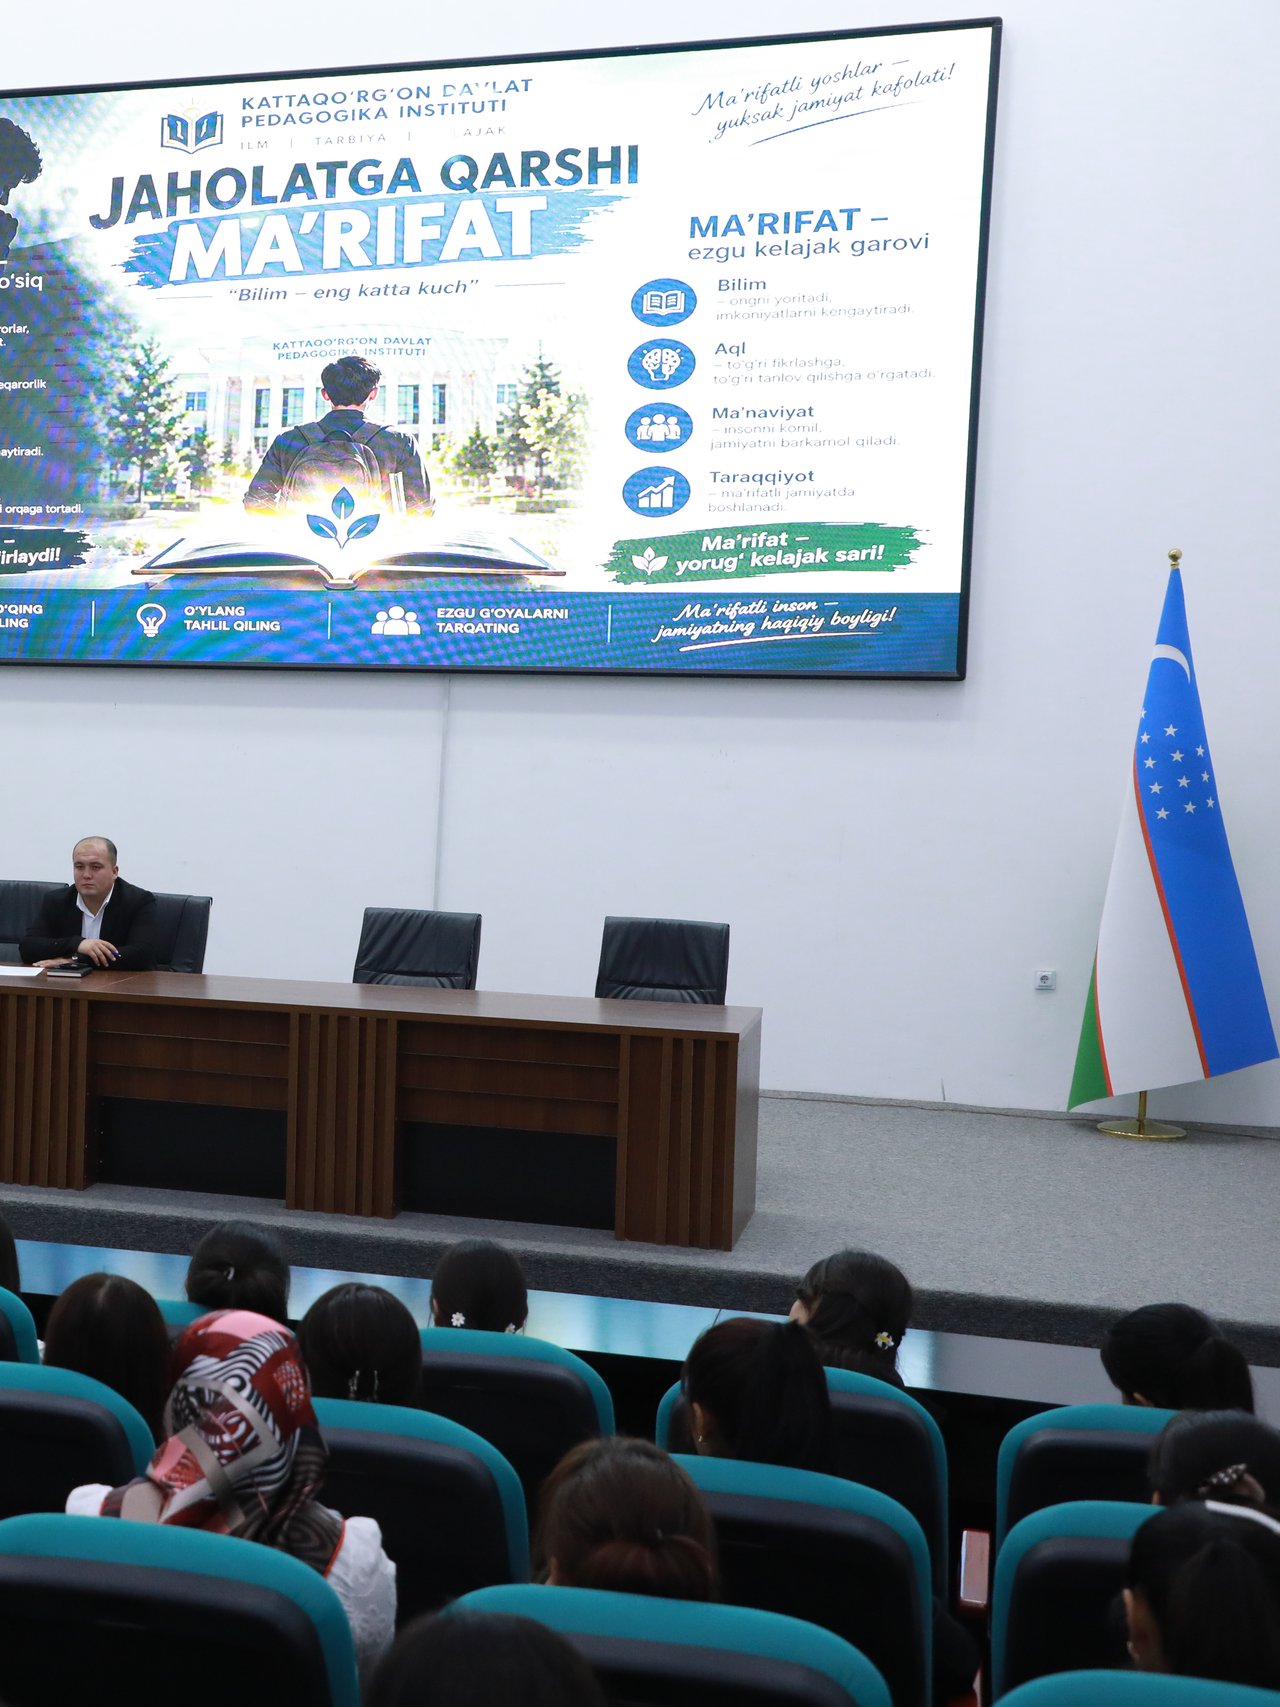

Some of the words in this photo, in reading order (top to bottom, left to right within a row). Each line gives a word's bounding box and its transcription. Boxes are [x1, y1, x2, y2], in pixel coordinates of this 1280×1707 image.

[811, 60, 882, 94] yoshlar
[715, 104, 784, 139] yuksak
[790, 88, 864, 121] jamiyat
[871, 62, 955, 97] kafolati!
[241, 106, 389, 128] PEDAGOGIKA
[400, 99, 507, 119] INSTITUTI
[240, 140, 269, 150] ILM
[315, 133, 387, 146] TARBIYA
[89, 157, 422, 230] JAHOLATGA
[440, 145, 639, 196] QARSHI
[688, 246, 746, 263] ezgu
[756, 238, 841, 259] kelajak
[851, 233, 930, 257] garovi
[314, 287, 352, 302] eng
[358, 281, 410, 299] katta
[718, 278, 767, 292] Bilim
[730, 296, 769, 308] ongni
[716, 308, 817, 321] imkoniyatlarni
[384, 337, 432, 346] DAVLAT
[278, 348, 358, 360] PEDAGOGIKA
[365, 347, 426, 356] INSTITUTI
[715, 342, 746, 356] Aql
[758, 371, 802, 384] tanlov
[806, 370, 862, 385] qilishga
[724, 424, 775, 435] insonni
[710, 438, 776, 450] jamiyatni
[781, 436, 850, 448] barkamol
[710, 470, 815, 486] Taraqqiyot
[785, 486, 855, 500] jamiyatda
[5, 505, 43, 515] orqaga
[45, 503, 83, 514] tortadi.
[750, 550, 829, 570] kelajak
[835, 545, 885, 563] sari!
[436, 607, 476, 619] EZGU
[772, 600, 818, 614] inson
[183, 619, 231, 631] TAHLIL
[233, 620, 281, 633] QILING
[436, 621, 520, 635] TARQATING
[650, 620, 756, 643] jamiyatning
[760, 614, 825, 633] haqiqiy
[830, 606, 898, 630] boyligi!
